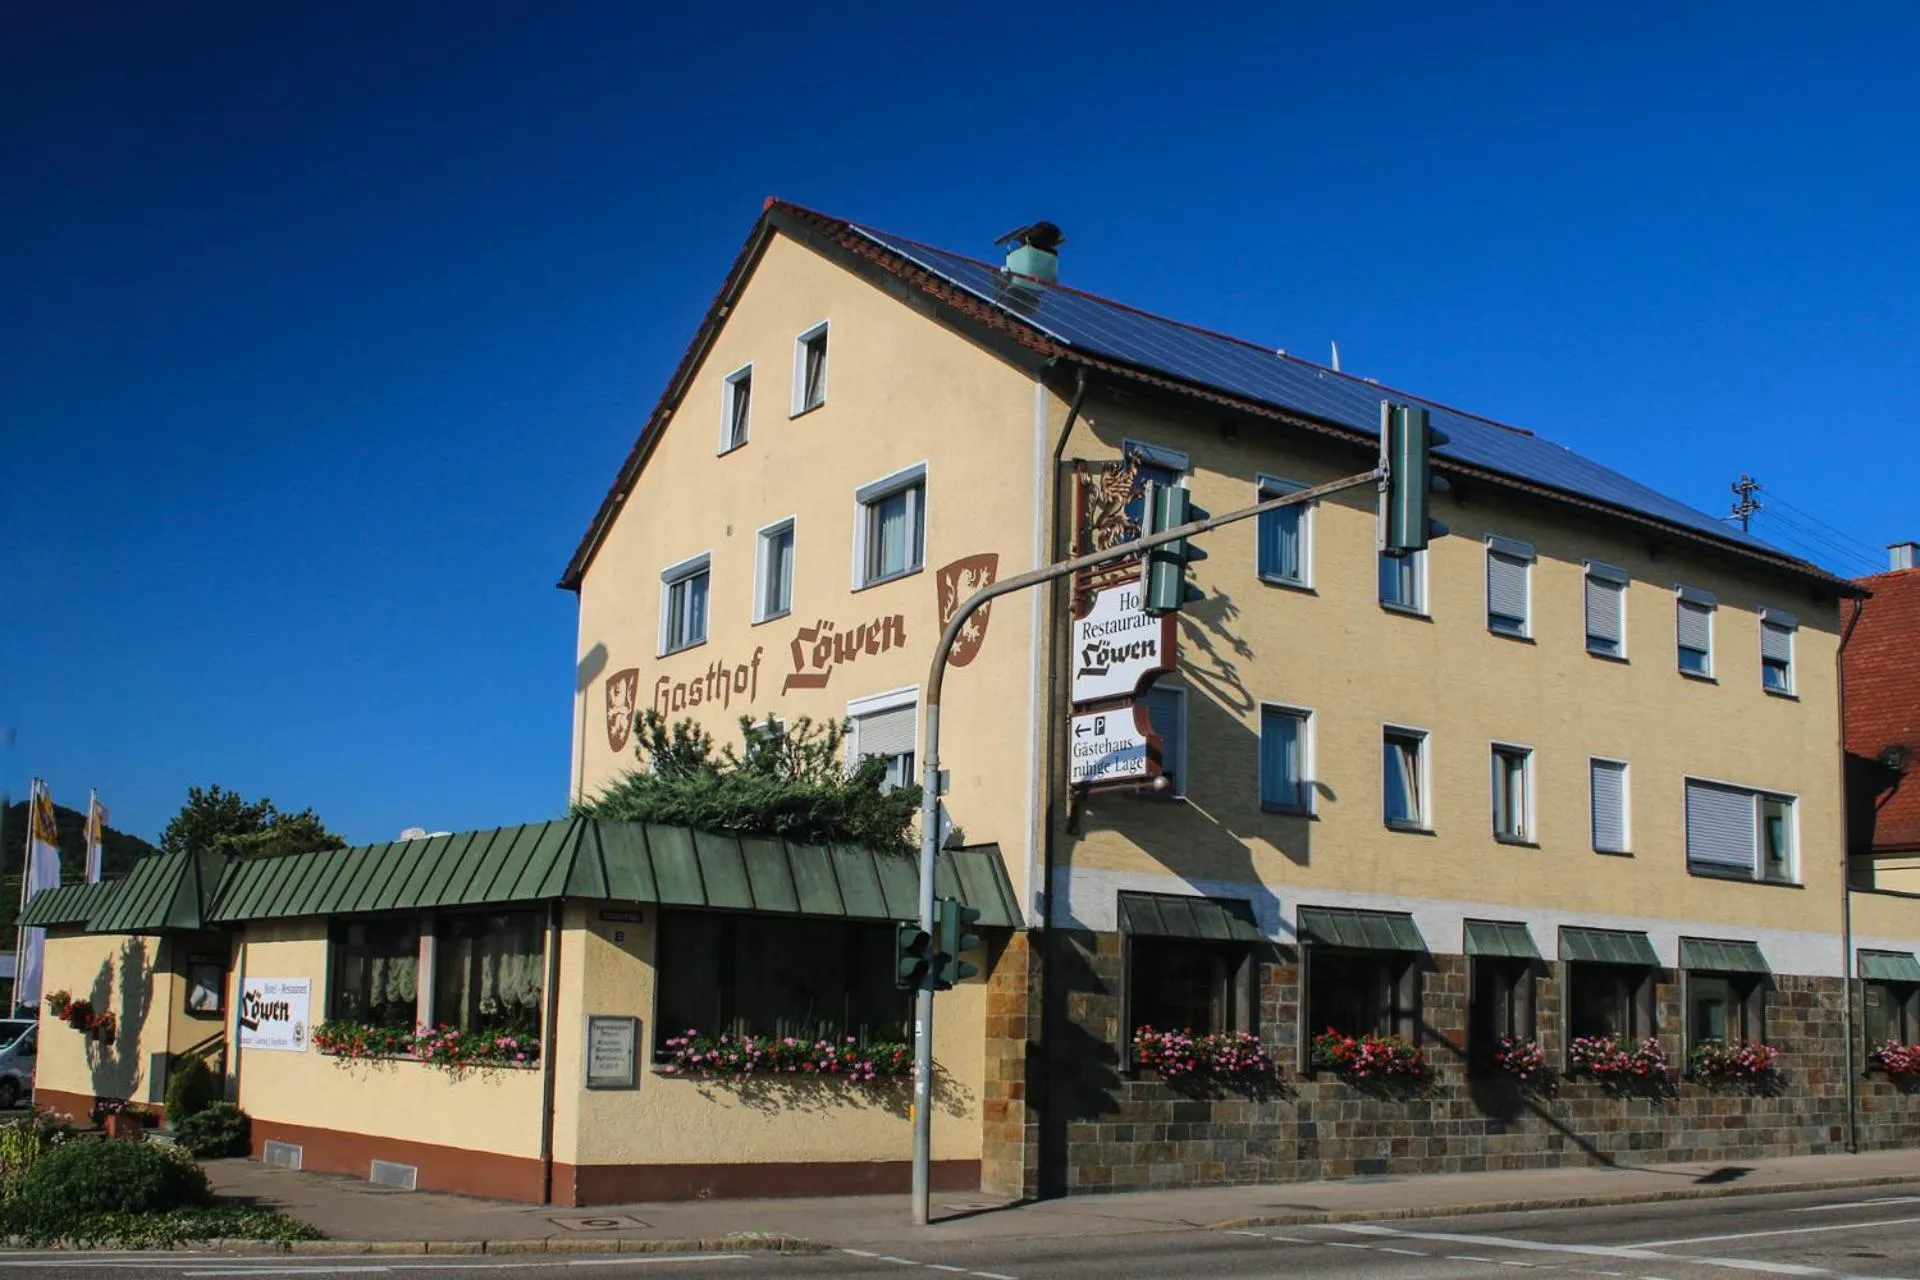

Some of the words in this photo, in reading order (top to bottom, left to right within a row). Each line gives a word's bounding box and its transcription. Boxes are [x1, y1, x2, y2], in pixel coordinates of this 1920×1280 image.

[1120, 592, 1140, 612] Ho
[1082, 614, 1156, 640] Restaurant
[654, 646, 763, 723] Gasthof
[781, 614, 908, 697] Löwen
[1077, 639, 1157, 680] Löwen
[1073, 739, 1134, 758] Gästehaus
[1073, 761, 1111, 778] ruhige
[1115, 757, 1144, 774] Lage
[241, 989, 289, 1032] Löwen
